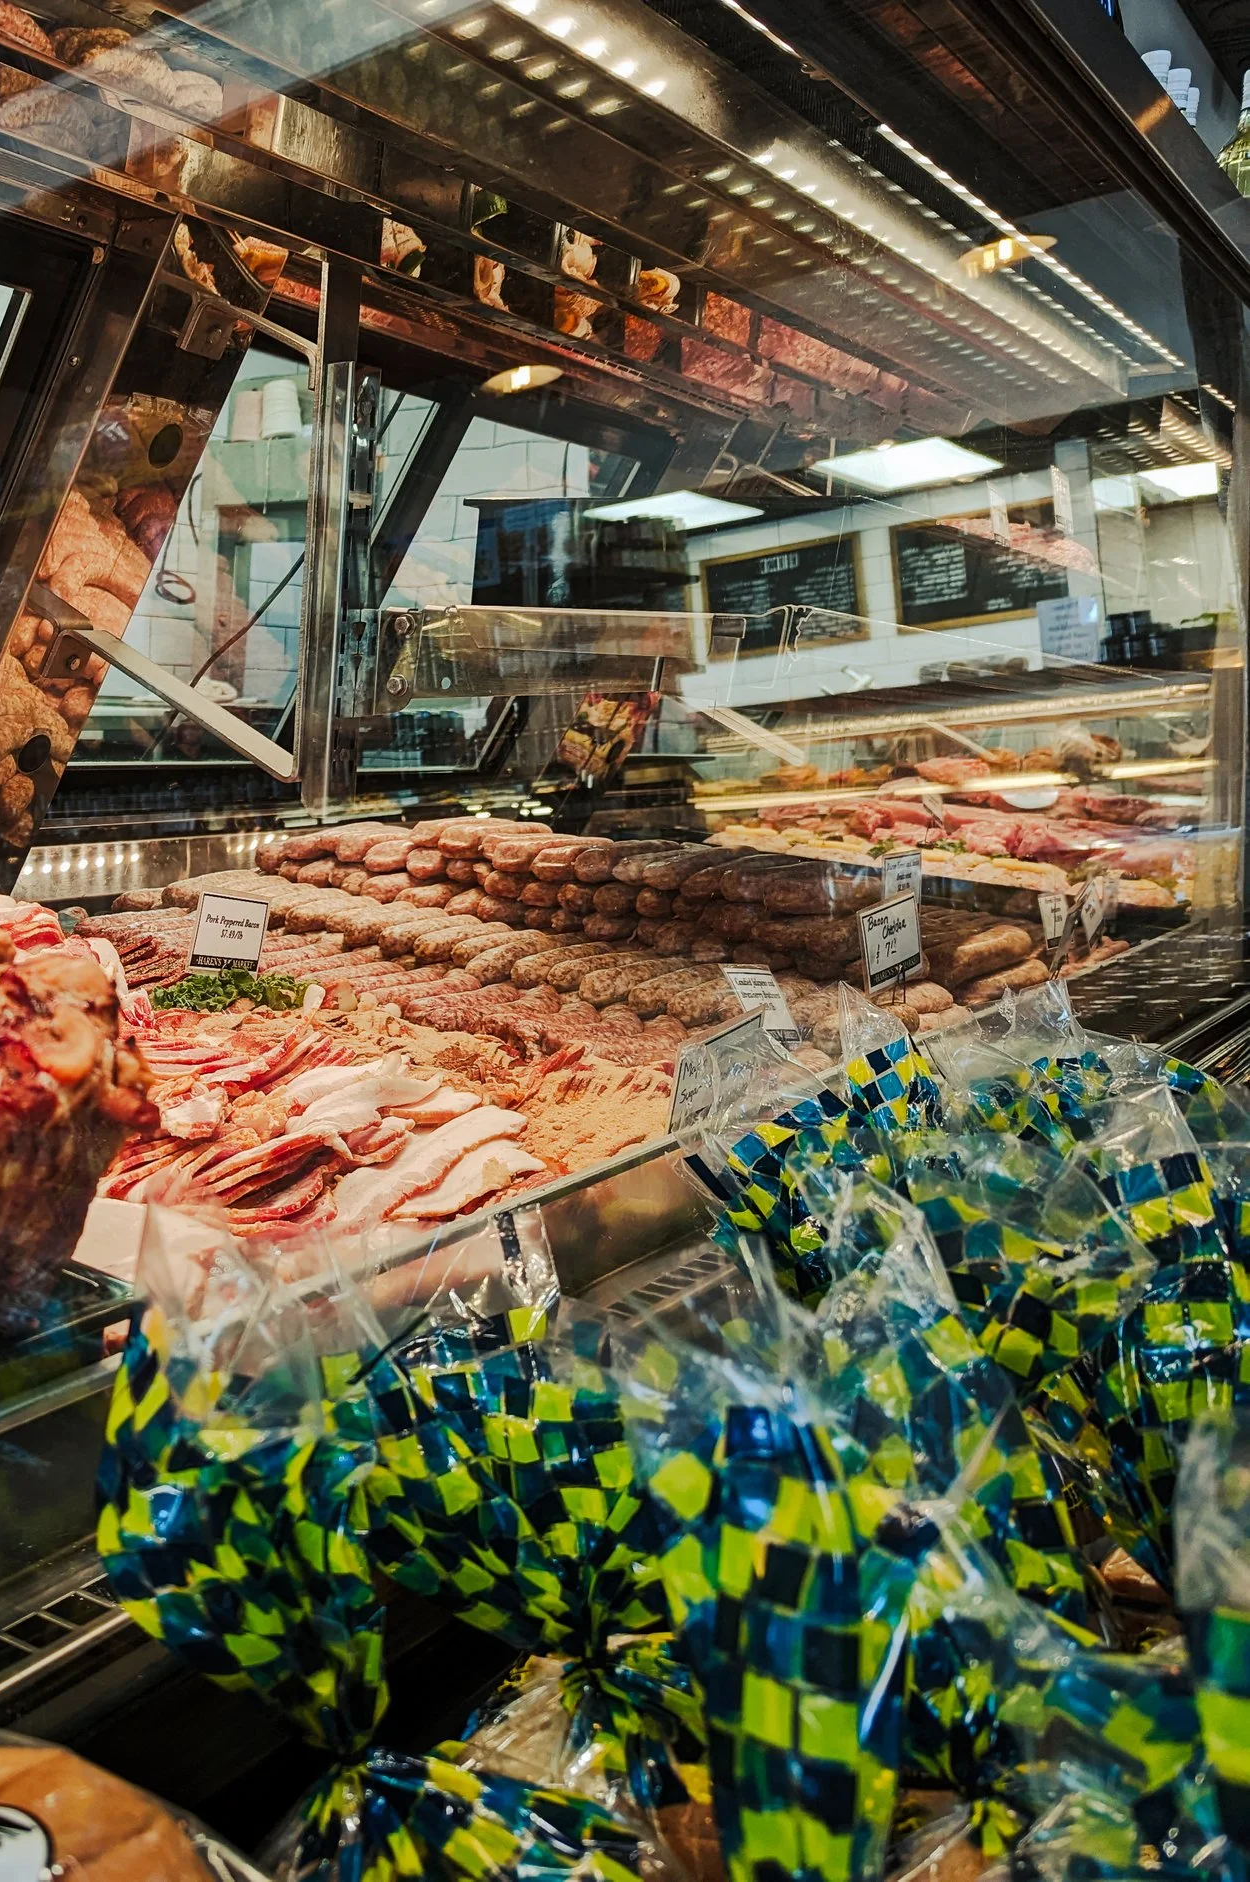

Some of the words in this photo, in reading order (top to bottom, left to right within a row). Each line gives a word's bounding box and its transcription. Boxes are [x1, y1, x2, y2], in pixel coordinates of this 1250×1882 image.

[205, 914, 219, 924] Pork
[220, 916, 244, 928] Peppered
[245, 919, 259, 928] Bacon
[221, 929, 243, 939] $7.49/lb
[679, 1085, 702, 1104] Sugar
